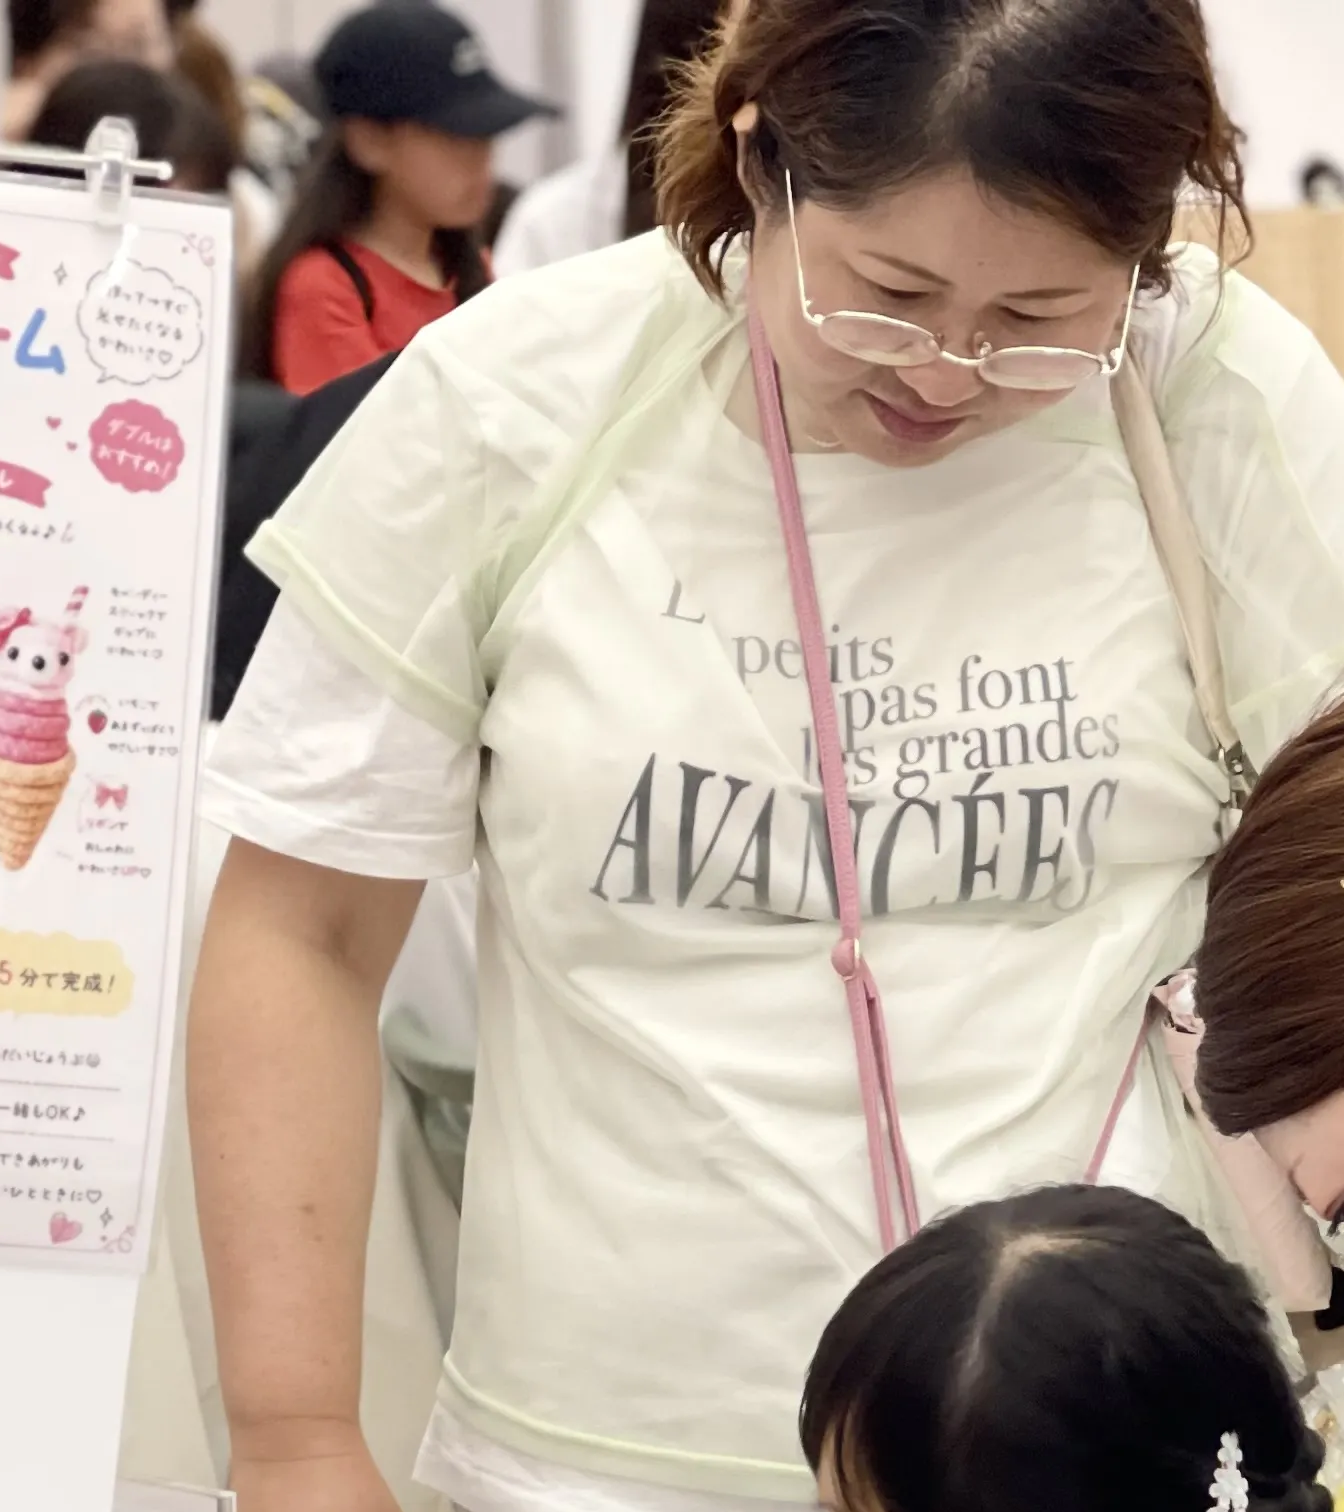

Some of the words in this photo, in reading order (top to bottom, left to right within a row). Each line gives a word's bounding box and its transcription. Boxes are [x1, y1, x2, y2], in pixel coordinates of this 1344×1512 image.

[731, 623, 896, 687] peits
[839, 679, 939, 754] pas
[955, 654, 1079, 715] font
[799, 726, 878, 787] ls
[892, 699, 1122, 801] grandes
